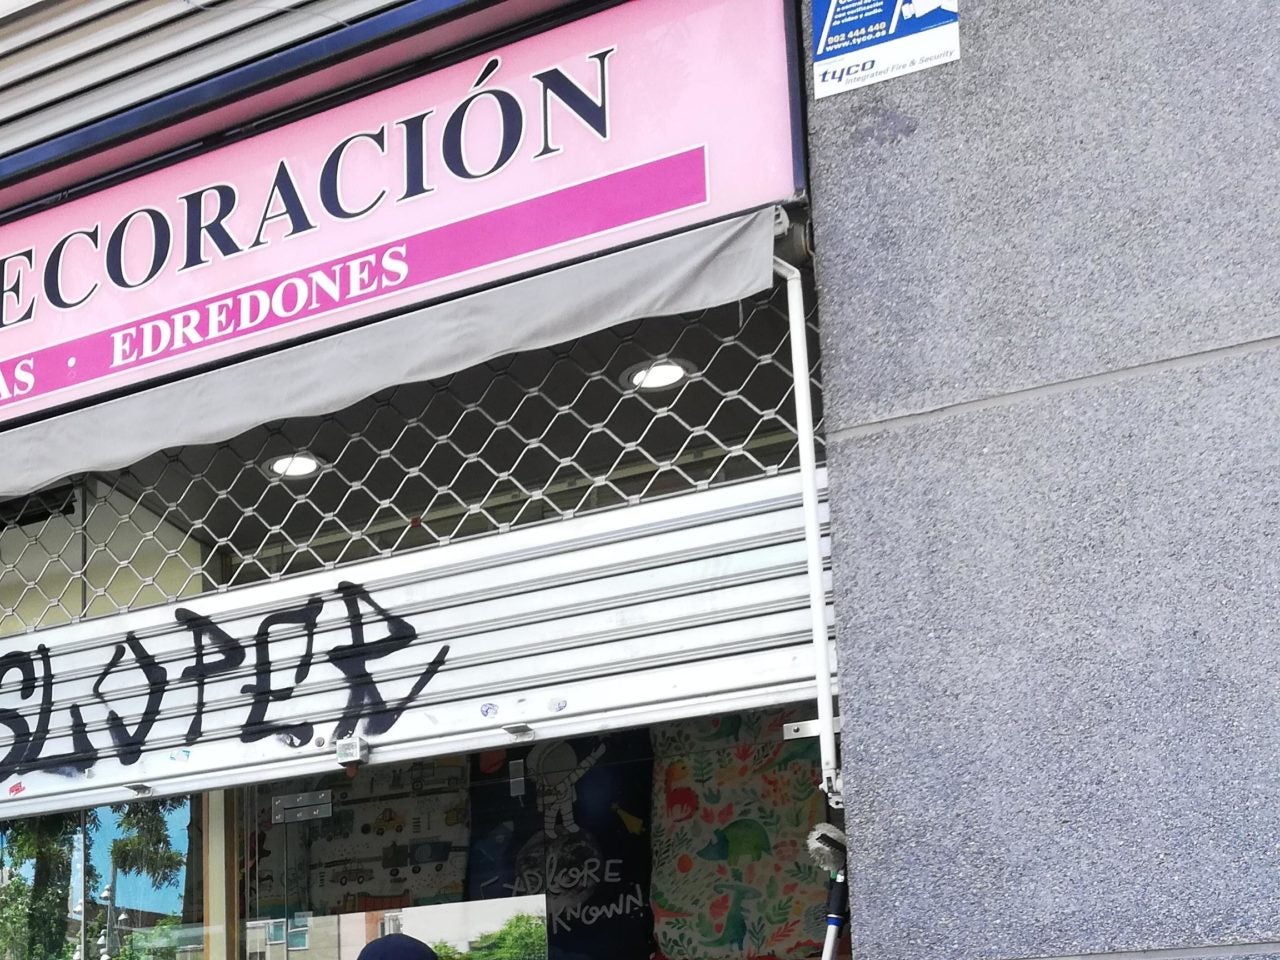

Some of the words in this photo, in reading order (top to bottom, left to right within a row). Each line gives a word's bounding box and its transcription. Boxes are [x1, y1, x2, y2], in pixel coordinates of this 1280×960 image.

[825, 30, 887, 52] www.tyco.es
[827, 33, 846, 44] 902
[847, 27, 866, 38] 444
[819, 59, 876, 83] tyco
[845, 68, 889, 85] Integrated
[891, 62, 908, 72] Fire
[919, 50, 955, 63] Security
[109, 245, 410, 371] EDREDONES
